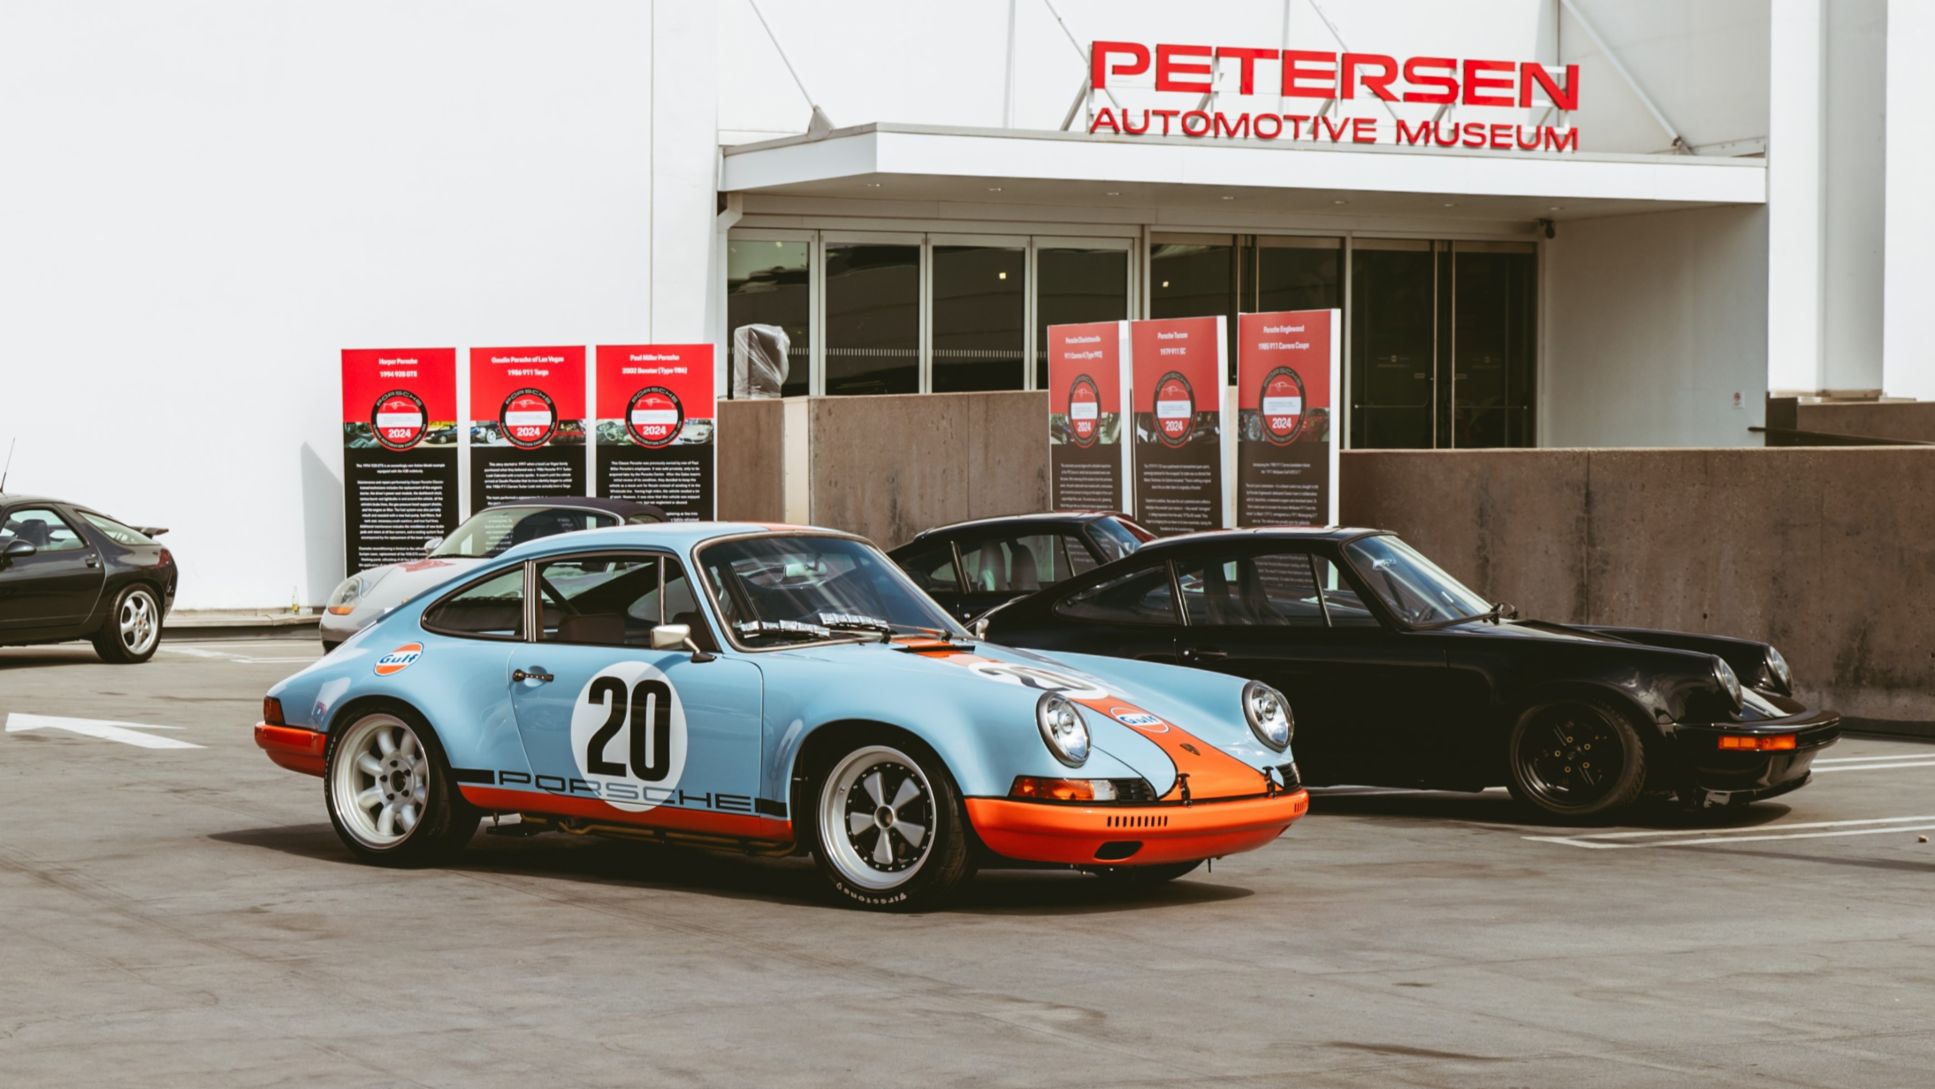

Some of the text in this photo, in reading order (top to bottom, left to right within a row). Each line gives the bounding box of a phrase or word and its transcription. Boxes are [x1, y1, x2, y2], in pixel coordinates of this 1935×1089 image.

[1090, 40, 1579, 111] PETERSEN
[1090, 106, 1578, 152] AUTOMOTIVE MUSEUM
[548, 355, 565, 364] Vegas
[376, 391, 422, 407] PORSCHE
[505, 389, 552, 405] PORSCHE
[631, 387, 679, 404] PORSCHE
[1077, 421, 1092, 433] 2024
[1165, 420, 1184, 432] 2024
[1272, 417, 1292, 430] 2024
[388, 428, 411, 439] 2024
[516, 427, 541, 437] 2024
[643, 425, 666, 436] 2024
[379, 653, 418, 664] Gulf
[586, 675, 672, 782] 20
[498, 770, 752, 813] PORSCHE
